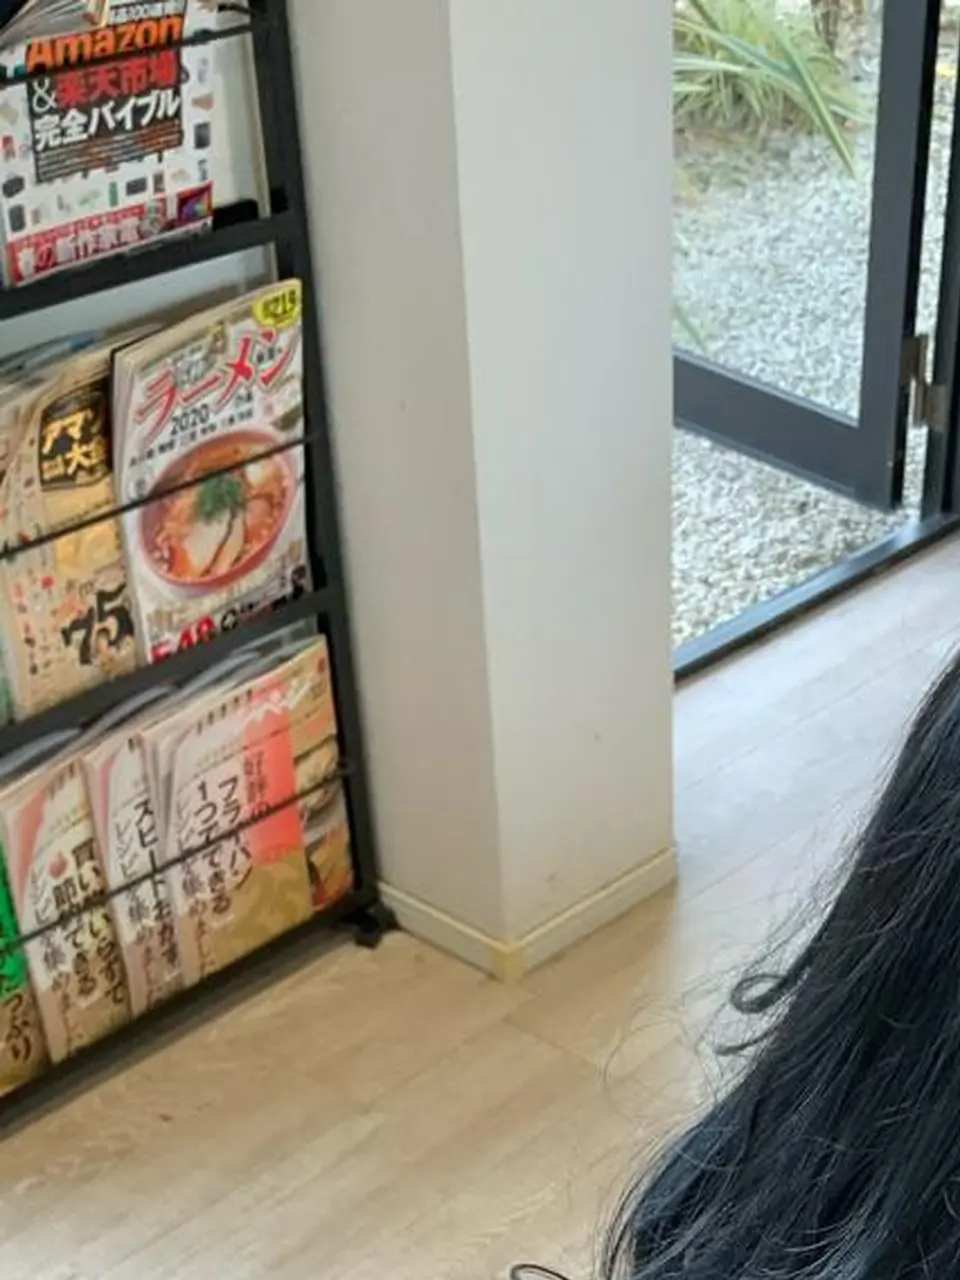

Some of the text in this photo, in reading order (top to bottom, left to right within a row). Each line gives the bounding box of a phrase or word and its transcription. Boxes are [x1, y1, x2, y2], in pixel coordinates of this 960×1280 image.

[28, 17, 182, 72] Amazon
[135, 327, 298, 445] ラーメン
[170, 403, 210, 436] 2020
[60, 582, 135, 665] 75
